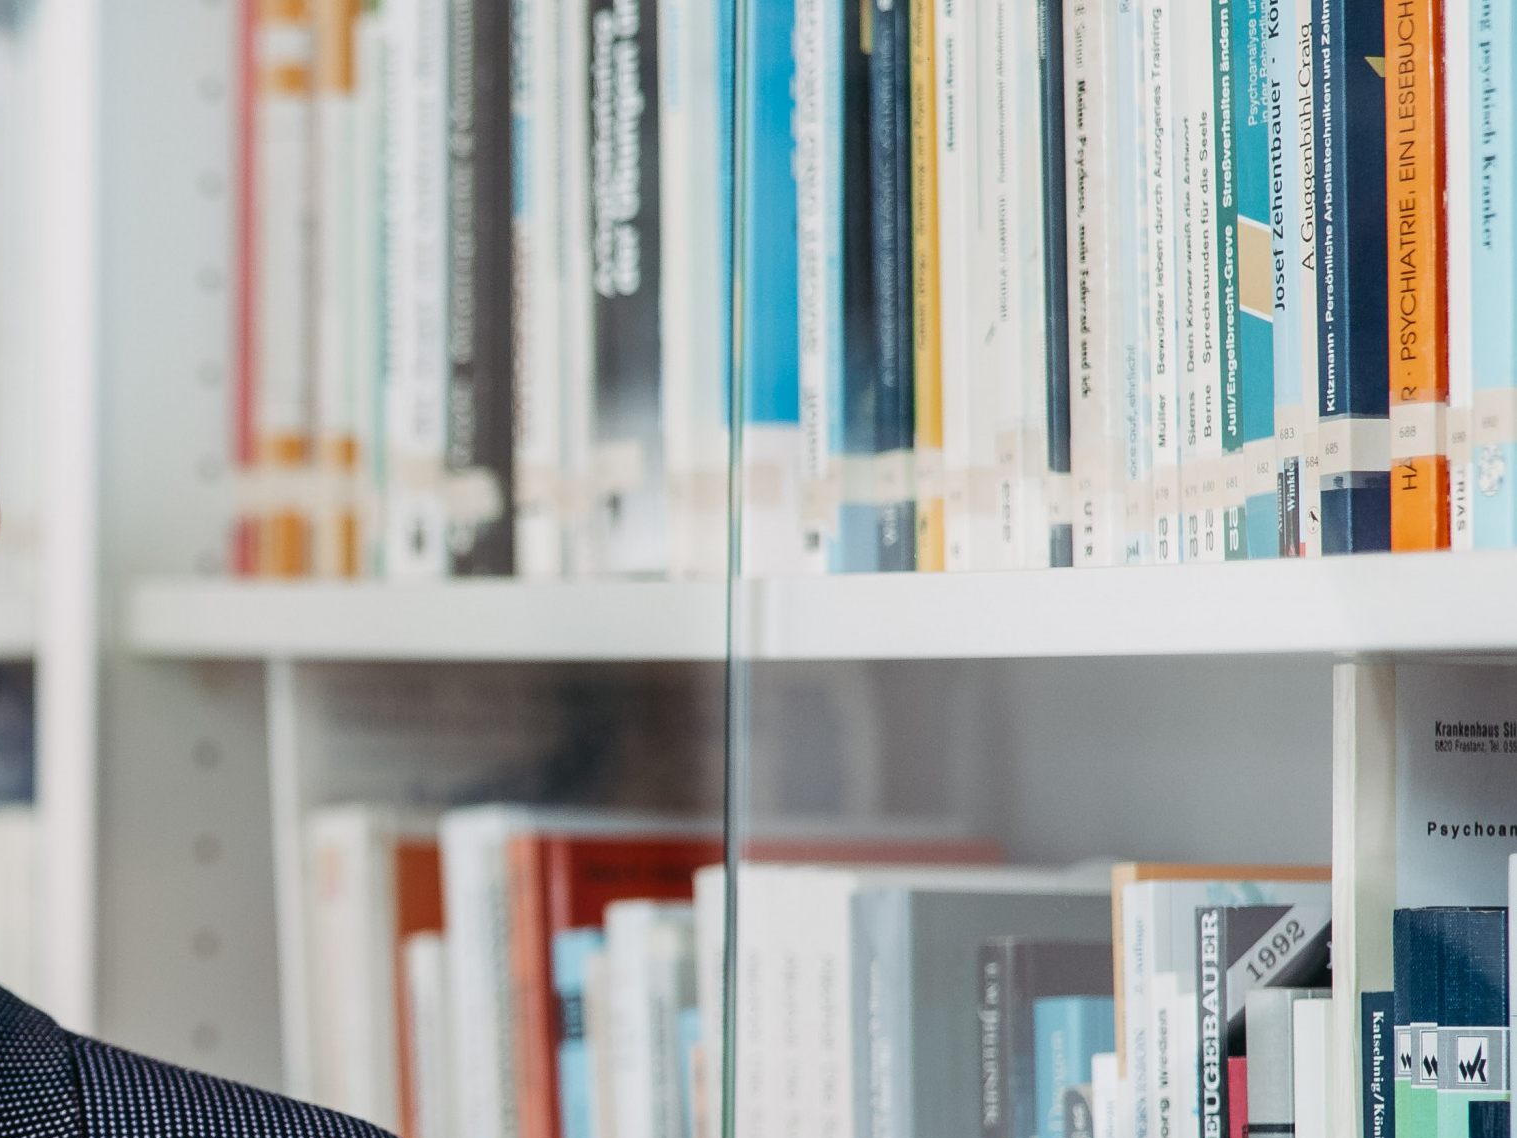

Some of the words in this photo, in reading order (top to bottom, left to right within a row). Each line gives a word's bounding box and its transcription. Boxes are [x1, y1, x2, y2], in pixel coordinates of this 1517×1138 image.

[1150, 7, 1162, 80] Training
[1218, 8, 1230, 73] ändern
[1247, 18, 1259, 127] Psychoanalyse
[1320, 48, 1331, 79] und
[1397, 0, 1415, 133] LESEBUCH
[1479, 41, 1497, 145] psychisch
[1151, 85, 1164, 179] Autogenes
[1198, 111, 1208, 161] Seele
[1219, 75, 1233, 208] Streßverhalten
[1269, 79, 1285, 240] Zehentbauer
[1297, 23, 1316, 243] Guggenbühl-Craig
[1321, 82, 1334, 222] Arbeitstechniken
[1398, 140, 1416, 181] EIN
[1152, 184, 1164, 235] durch
[1199, 167, 1209, 193] die
[1199, 199, 1210, 224] für
[1482, 155, 1497, 250] Kranker
[1154, 239, 1164, 288] leben
[1272, 249, 1285, 311] Josef
[1301, 245, 1315, 271] A.
[1323, 224, 1335, 322] Persönliche
[1398, 191, 1417, 360] PSYCHIATRIE,
[1201, 229, 1213, 364] Sprechstunden
[1223, 225, 1238, 436] Juli/Engelbrecht-Greve
[1325, 333, 1336, 412] Kitzmann
[1202, 384, 1213, 438] Berne
[1280, 430, 1295, 440] 683
[1306, 456, 1319, 468] 684
[1325, 443, 1339, 455] 685
[1435, 720, 1499, 737] Krankenhaus
[1245, 919, 1305, 983] 1992
